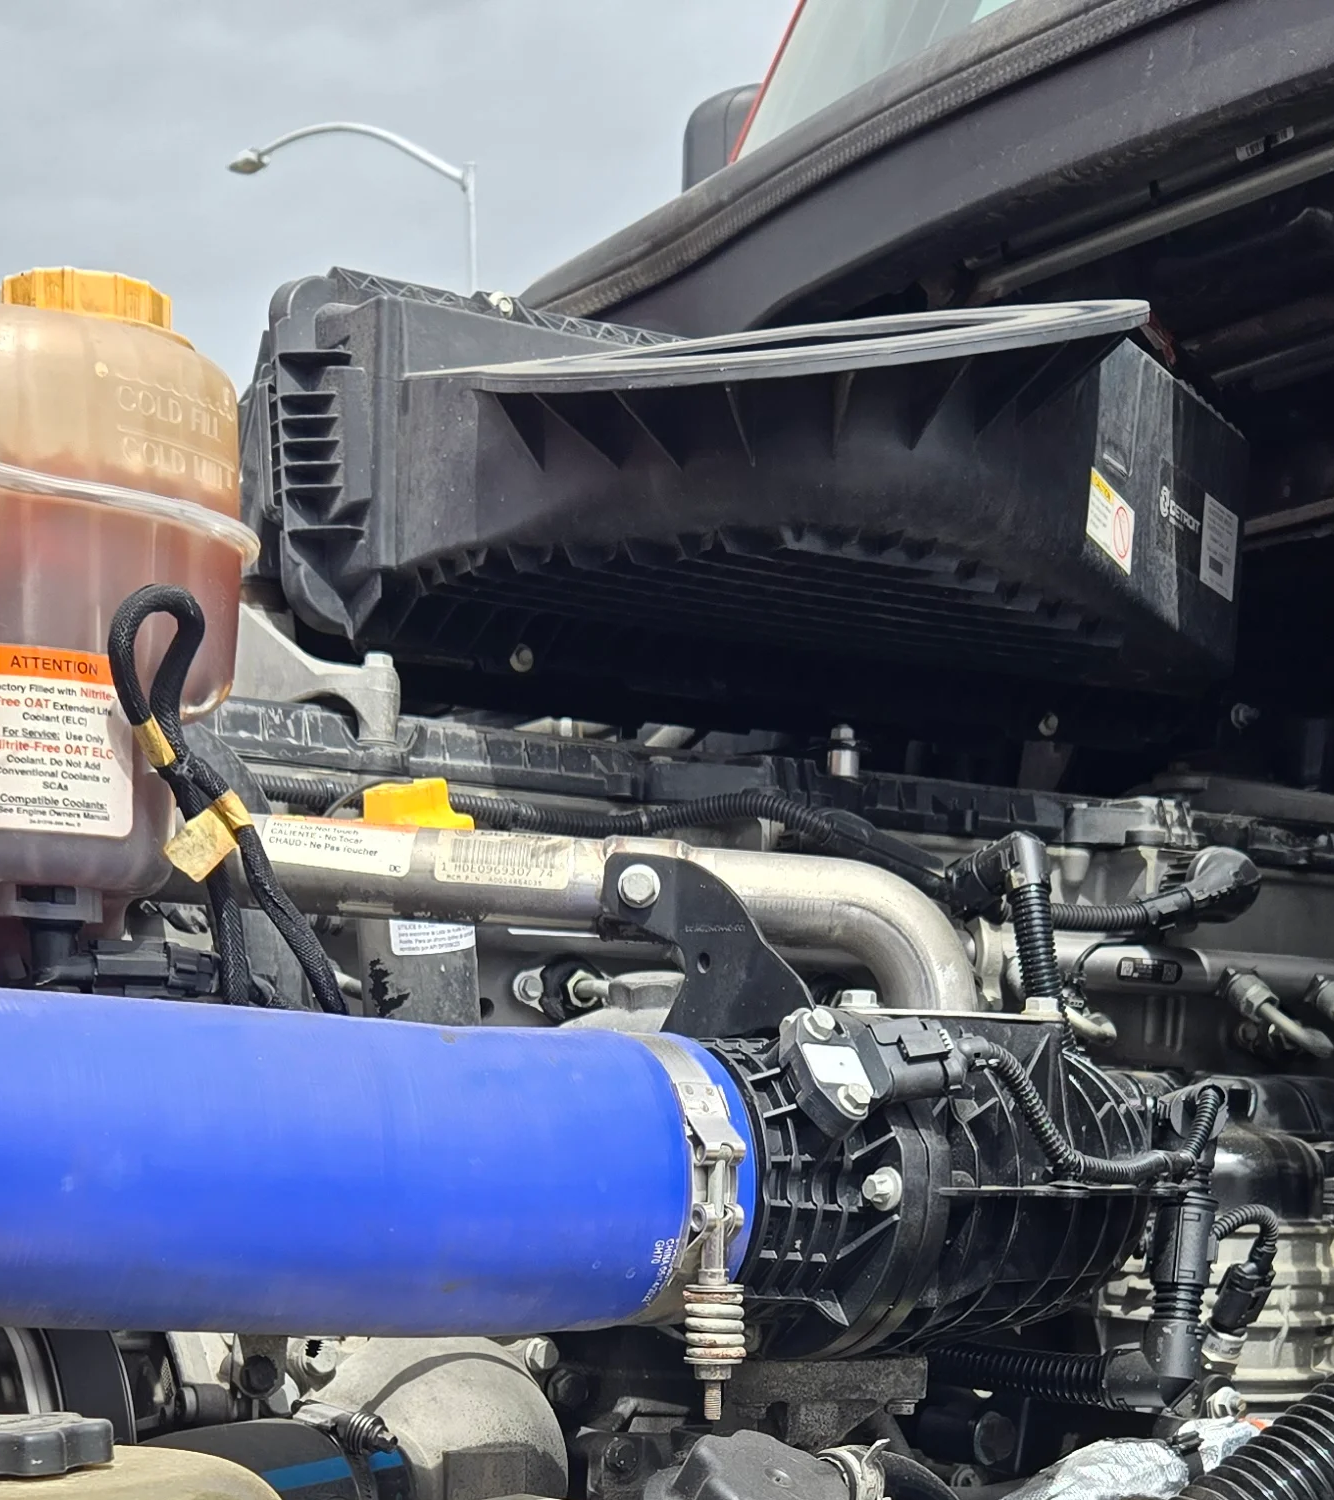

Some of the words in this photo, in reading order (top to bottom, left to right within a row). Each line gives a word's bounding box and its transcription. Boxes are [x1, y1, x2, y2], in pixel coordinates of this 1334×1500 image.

[118, 385, 183, 424] COLD
[123, 436, 186, 474] COLD
[1170, 500, 1200, 533] DETROIT
[11, 656, 98, 675] ATTENTION
[29, 684, 54, 694] Filled
[58, 687, 76, 696] with
[80, 688, 115, 701] Nitrite-
[25, 698, 51, 709] OAT
[53, 702, 95, 714] Extended
[23, 712, 59, 723] Coolant
[62, 716, 87, 726] (ELC)
[3, 727, 18, 736] For
[66, 732, 83, 741] Use
[86, 732, 104, 745] Only
[64, 744, 88, 756] OAT
[93, 748, 114, 759] ELC
[50, 758, 63, 766] Do
[66, 759, 81, 769] Not
[84, 761, 101, 770] Add
[61, 772, 99, 782] Coolants
[102, 775, 110, 783] or
[43, 782, 68, 791] SCAs
[0, 793, 59, 807] Compatible
[63, 798, 107, 811] Coolants:
[17, 806, 46, 816] Engine
[49, 809, 80, 819] Owners
[83, 811, 110, 821] Manual
[269, 837, 301, 846] CHAUD
[325, 843, 340, 851] Pas
[271, 828, 316, 839] CALIENTE
[340, 835, 363, 844] Tocar
[389, 864, 401, 873] DC
